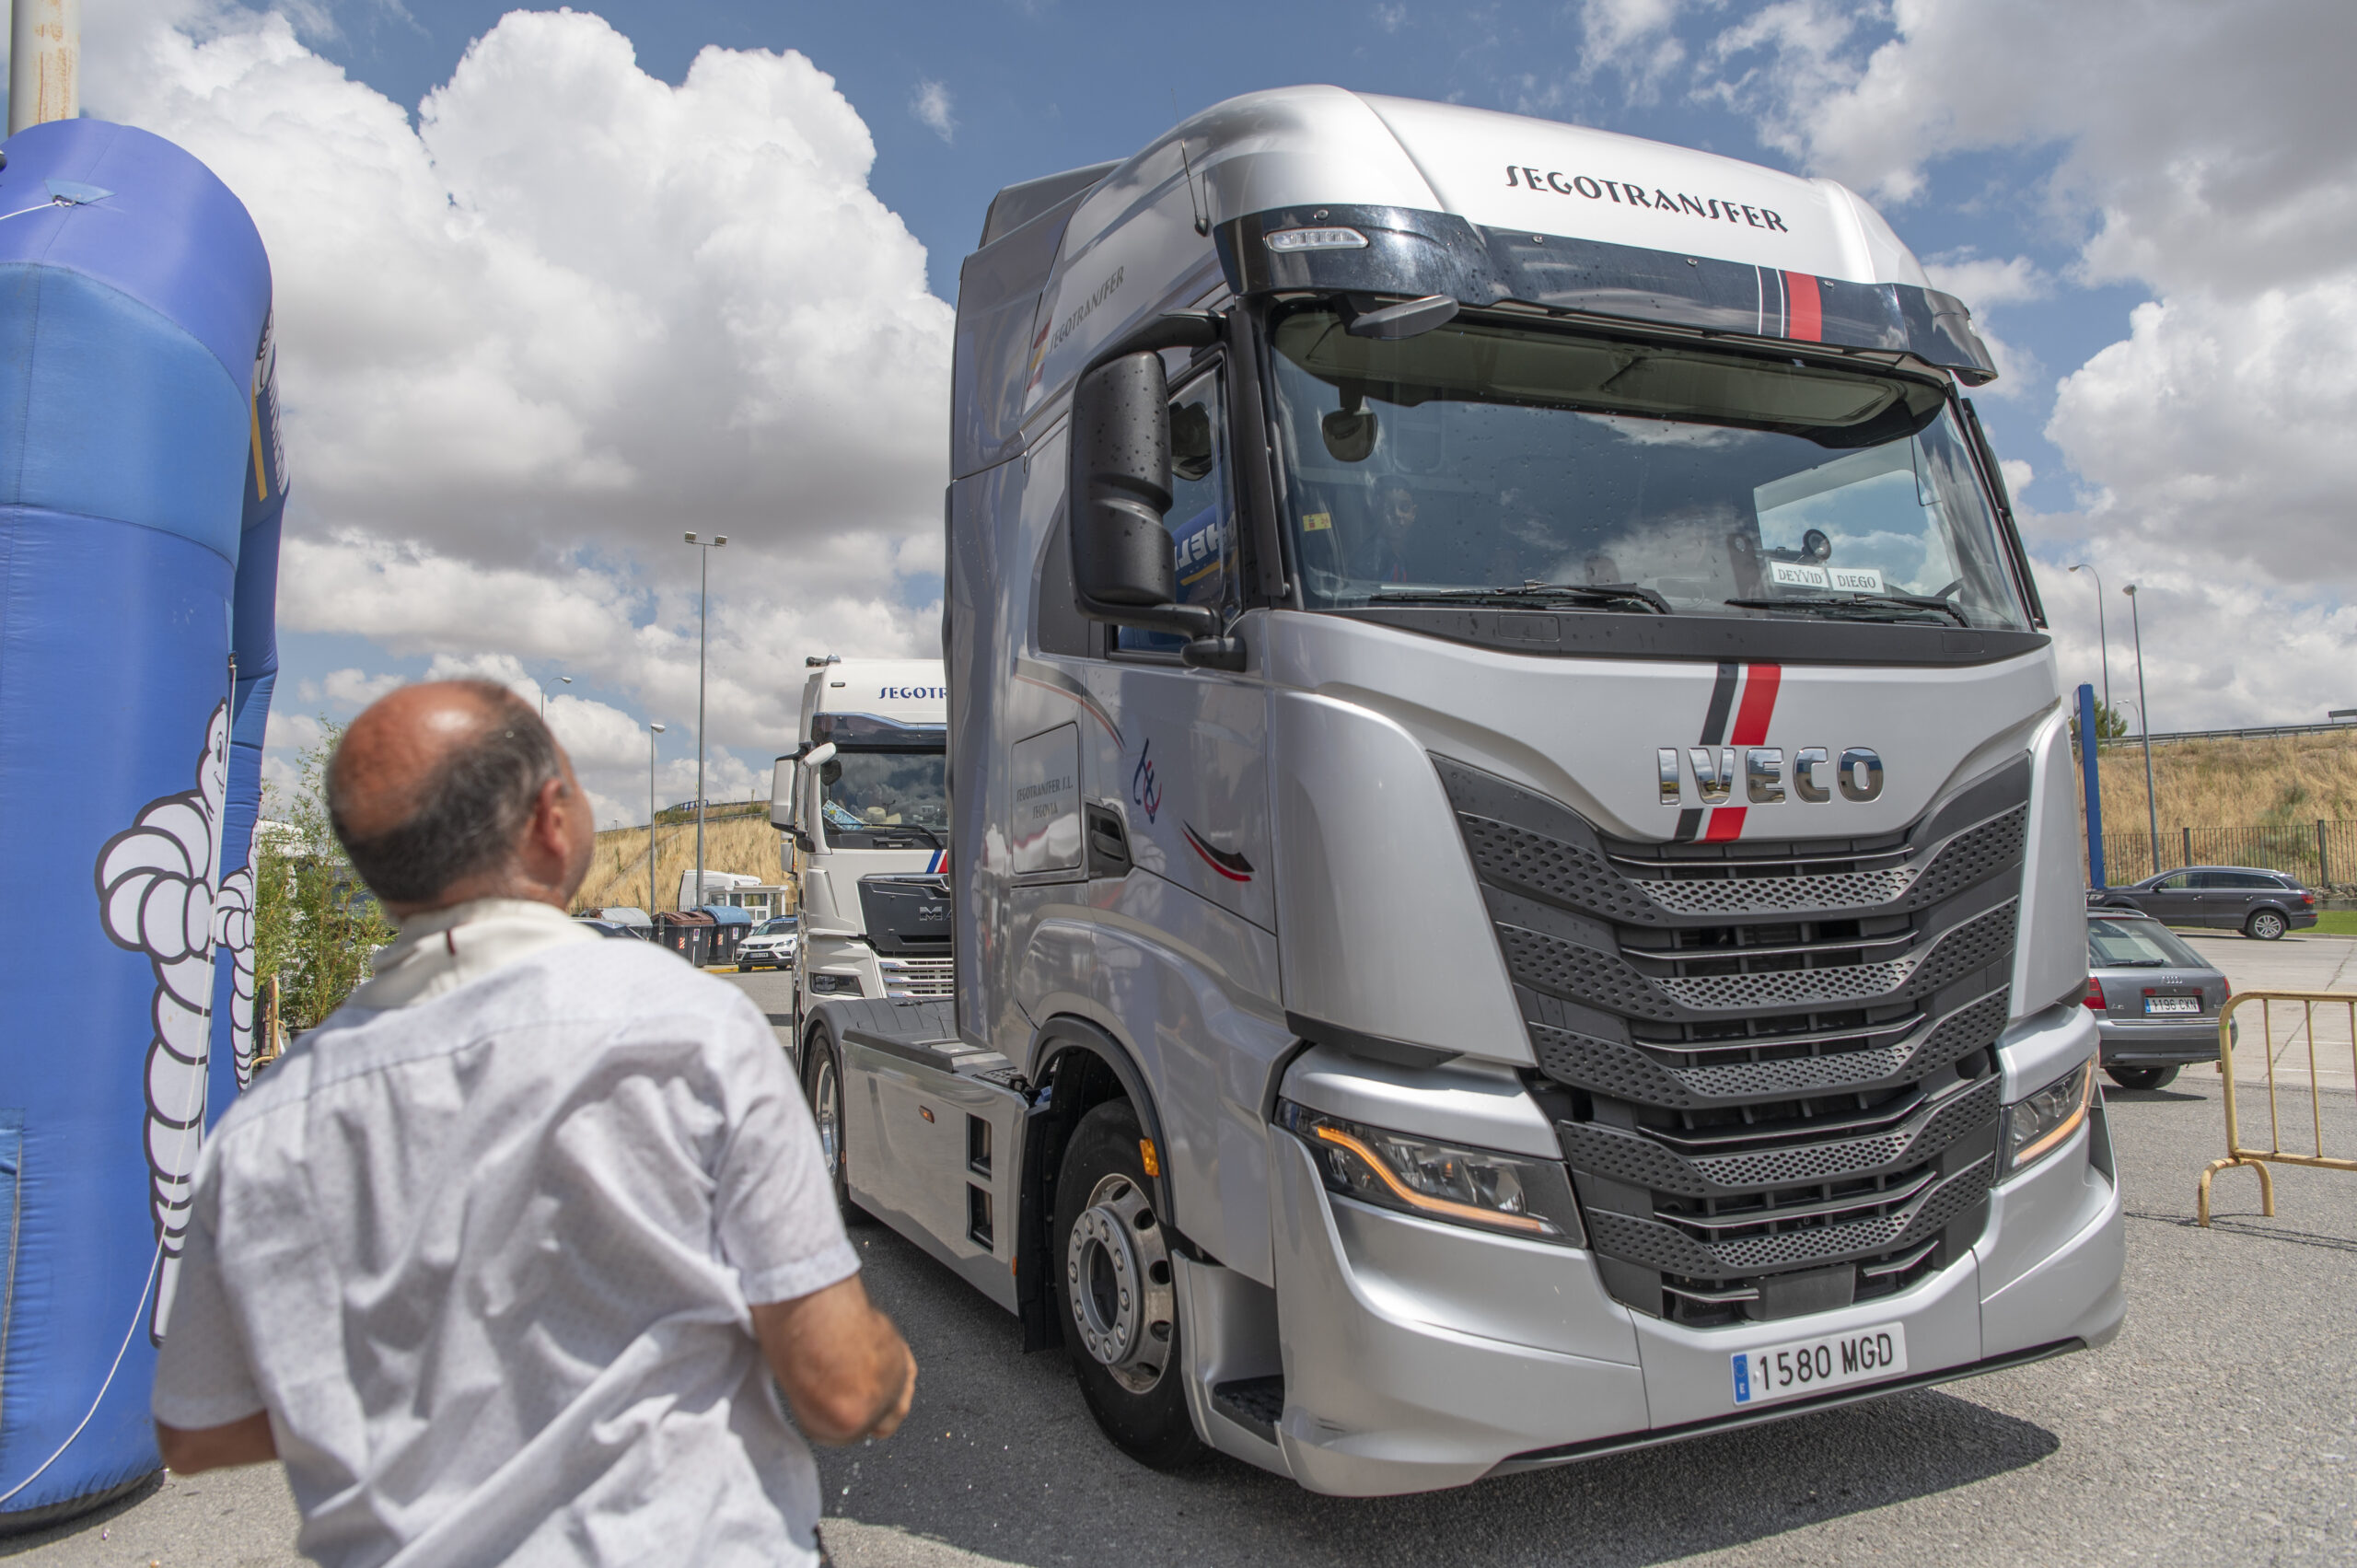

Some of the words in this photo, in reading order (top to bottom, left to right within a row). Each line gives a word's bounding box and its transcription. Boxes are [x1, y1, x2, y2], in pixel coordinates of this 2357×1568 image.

[1505, 166, 1788, 233] SEGOTRANSFER
[1049, 265, 1124, 354] SEGOTRANSFER
[1778, 568, 1823, 585] DEYVID
[1837, 575, 1876, 588] DIEGO
[1657, 747, 1885, 806] IVECO
[1016, 778, 1060, 802] SEGOTRANSFER
[1033, 801, 1059, 819] SEGOVIA
[2152, 999, 2177, 1011] 1196
[2178, 998, 2198, 1011] CXN
[1759, 1345, 1831, 1390] 1580
[1841, 1333, 1893, 1375] MGD
